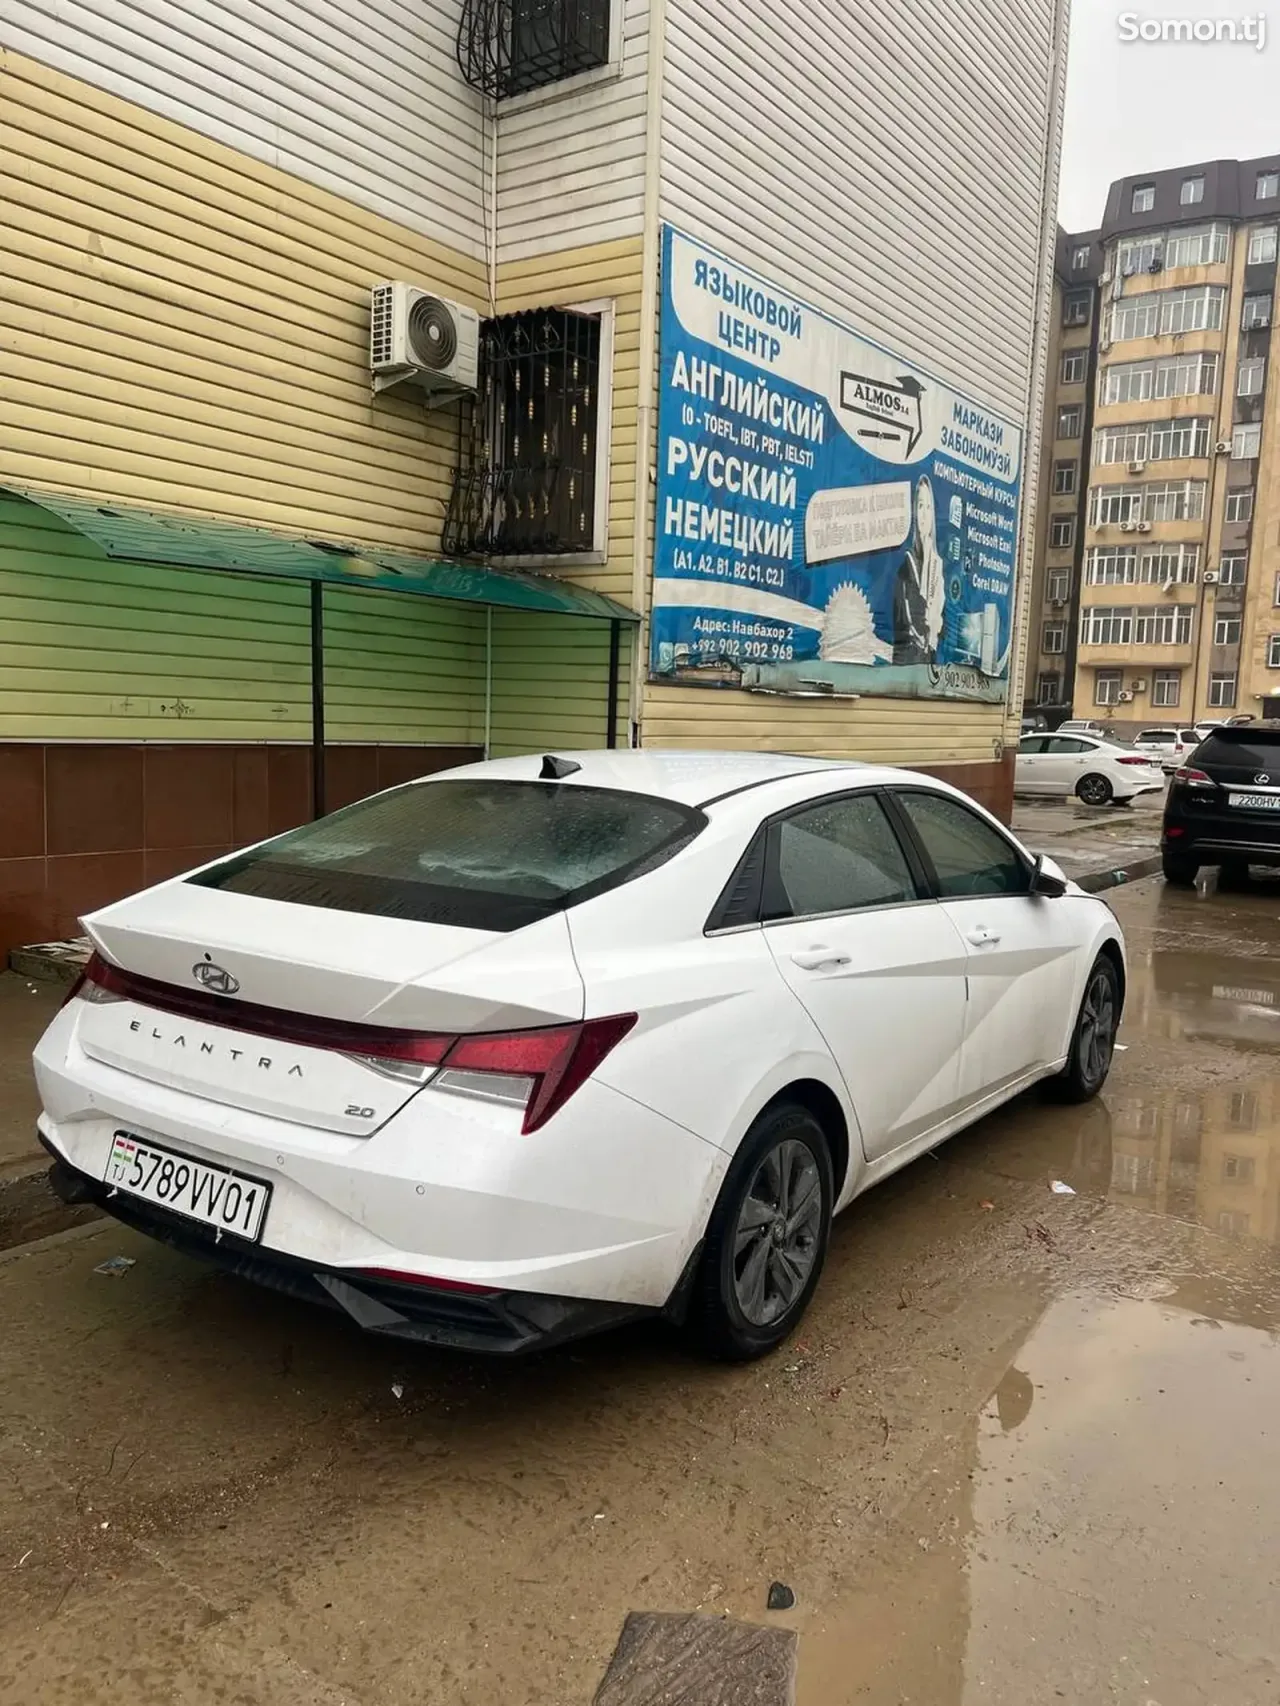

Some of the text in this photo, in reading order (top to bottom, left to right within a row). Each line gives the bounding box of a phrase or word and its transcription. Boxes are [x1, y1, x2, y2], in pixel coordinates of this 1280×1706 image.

[694, 258, 801, 339] ЯЗЫКОВОЙ
[718, 311, 780, 363] ЦЕНТР
[671, 350, 824, 445] АНГЛИЙСКИЙ
[704, 413, 739, 445] TOEFL,
[762, 435, 783, 461] PBT,
[953, 402, 1003, 446] МАРКАЗИ
[667, 436, 797, 509] РУССКИЙ
[664, 496, 793, 560] НЕМЕЦКИЙ
[966, 502, 997, 527] Microsoft
[967, 526, 998, 549] Microsoft
[734, 561, 746, 579] B2
[693, 616, 793, 641] Адрес: Навбахор 2
[719, 638, 740, 655] 902
[744, 641, 768, 658] 902
[772, 644, 793, 660] 968
[130, 1020, 303, 1077] ELANTRA
[112, 1164, 126, 1181] TJ
[128, 1149, 257, 1230] 5789VV01
